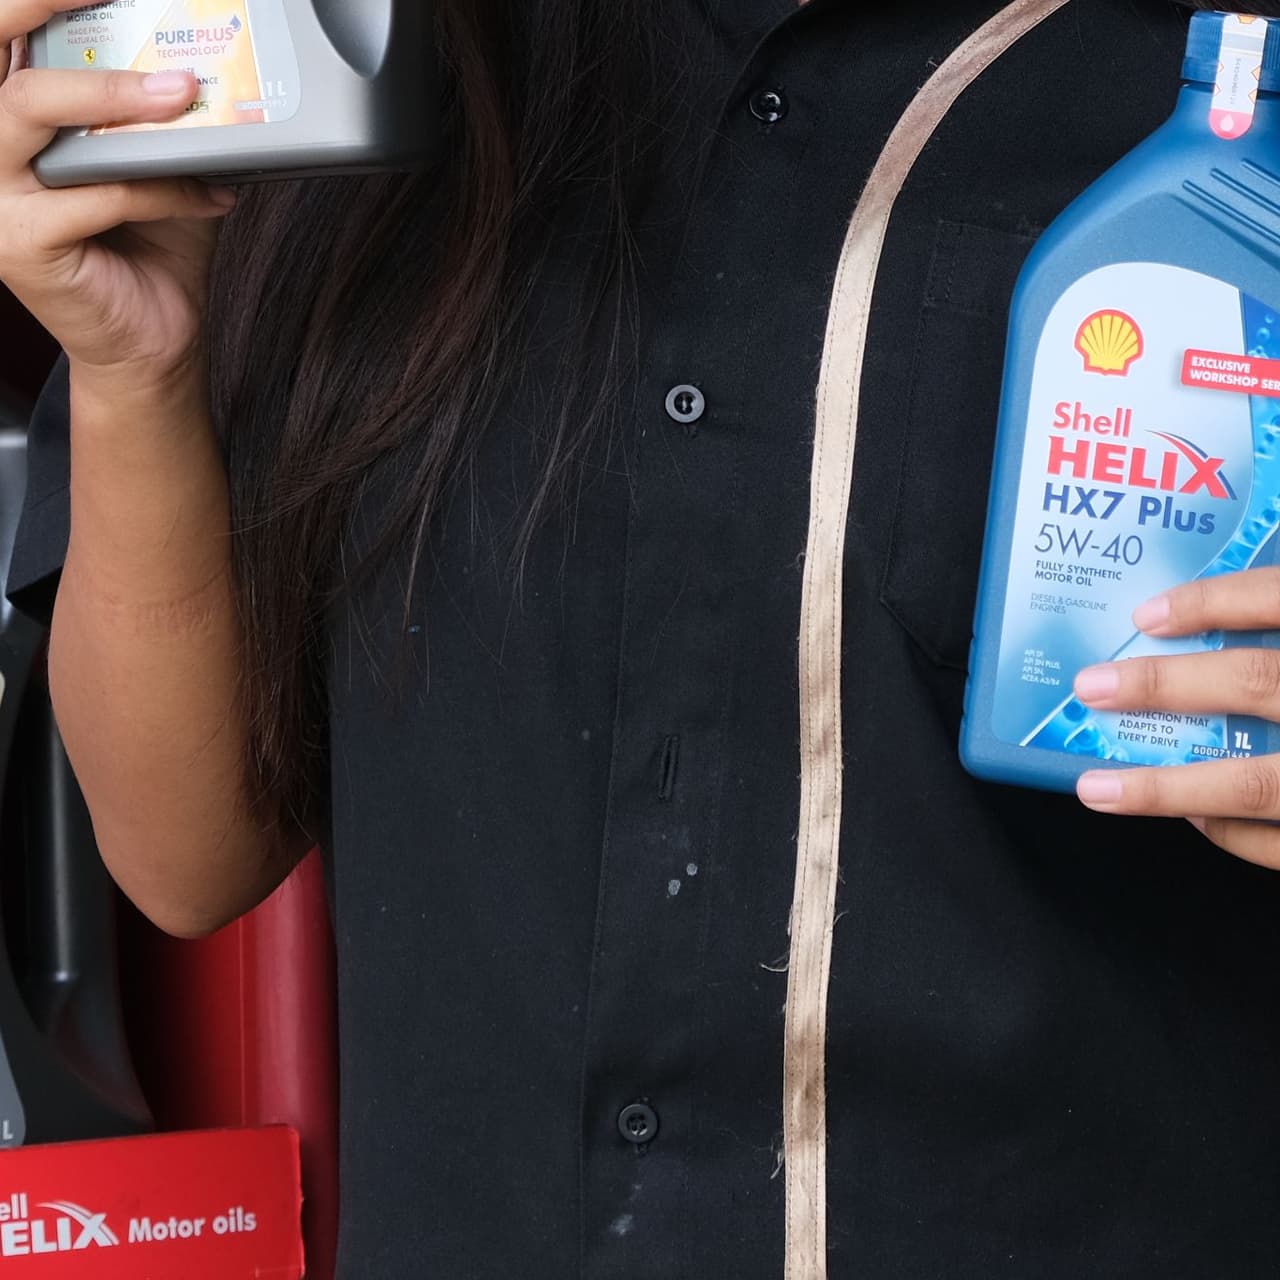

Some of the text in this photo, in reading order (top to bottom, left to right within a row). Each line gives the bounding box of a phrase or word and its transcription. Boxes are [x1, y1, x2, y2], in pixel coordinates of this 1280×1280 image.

[66, 11, 114, 22] MOTOR OIL
[155, 26, 235, 46] PUREPLUS
[157, 44, 228, 58] TECHNOLOGY
[1191, 356, 1251, 373] EXCLUSIVE
[1190, 369, 1258, 387] WORKSHOP
[1053, 401, 1132, 438] Shell
[1047, 434, 1238, 500] HELIX
[1043, 482, 1216, 535] HX7 Plus
[1034, 523, 1143, 566] 5W-40
[1035, 571, 1092, 586] MOTOR OIL
[1036, 560, 1122, 581] FULLY SYNTHETIC
[1030, 602, 1066, 614] ENGINES
[1065, 598, 1108, 611] GASOLINE
[1119, 719, 1173, 735] ADAPTS TO
[1185, 716, 1209, 727] THAT
[1117, 731, 1179, 748] EVERY DRIVE
[1235, 731, 1252, 750] 1L
[128, 1217, 205, 1243] Motor
[213, 1207, 256, 1234] oils
